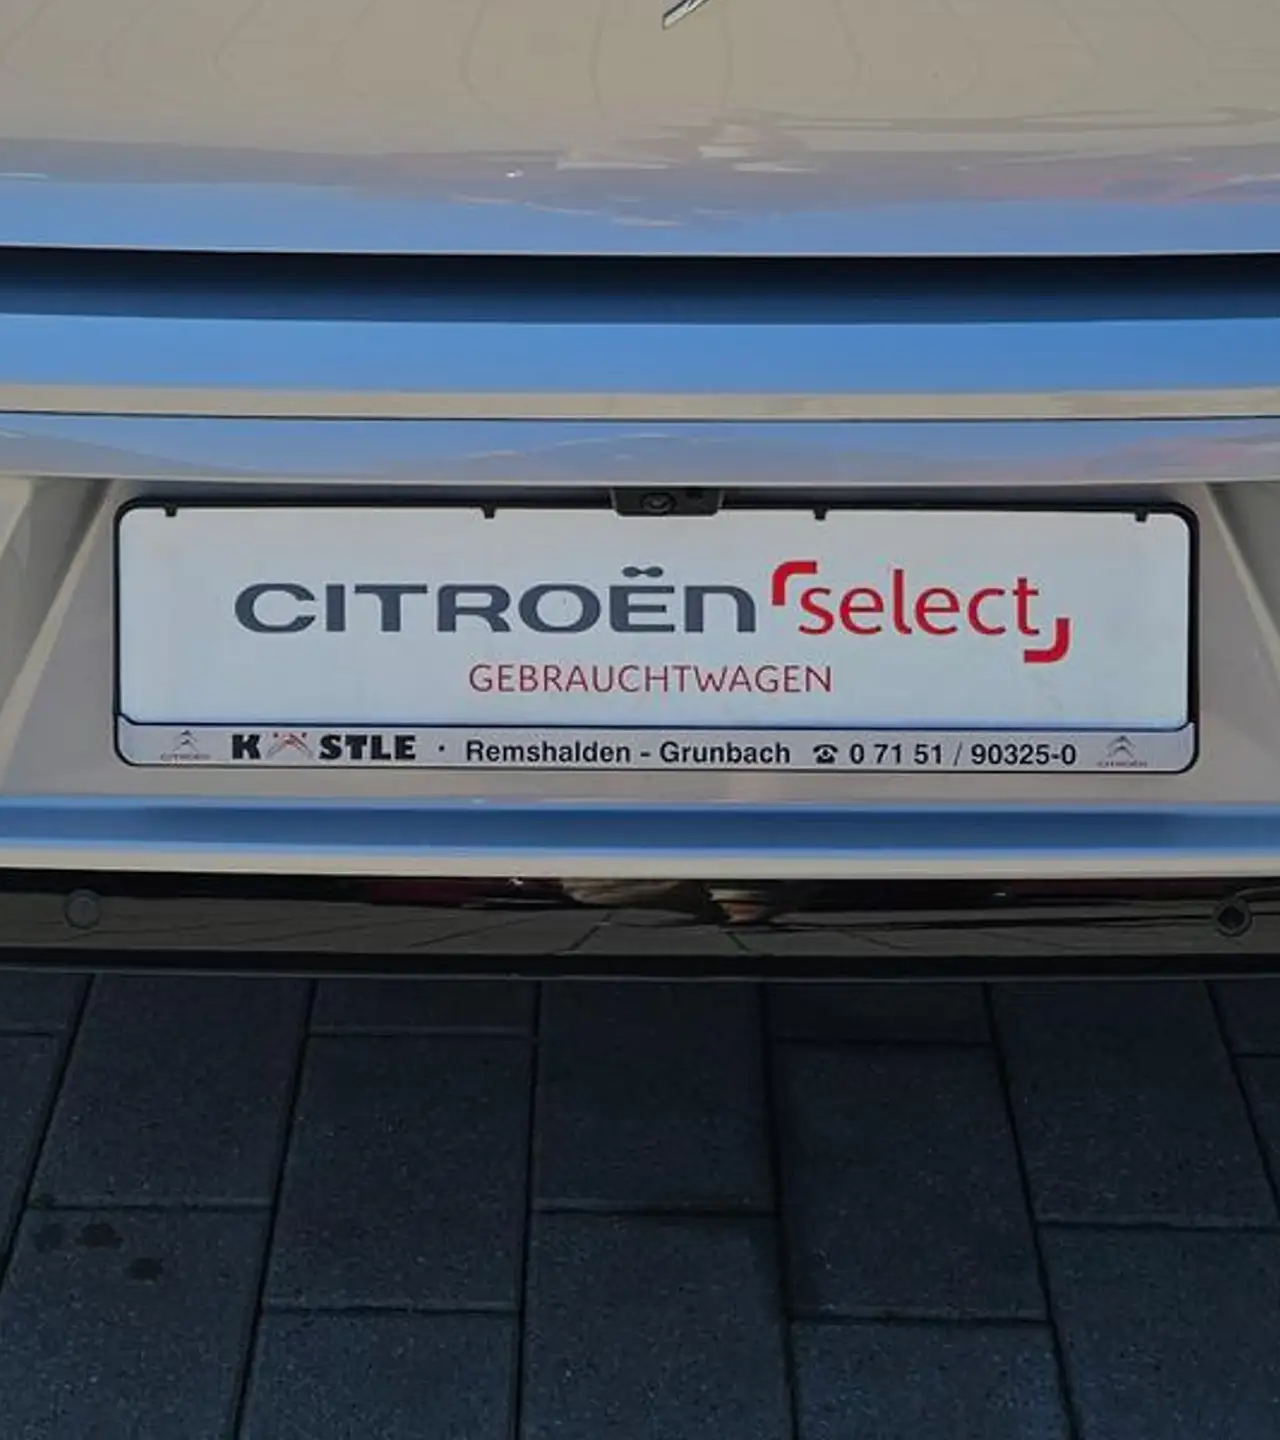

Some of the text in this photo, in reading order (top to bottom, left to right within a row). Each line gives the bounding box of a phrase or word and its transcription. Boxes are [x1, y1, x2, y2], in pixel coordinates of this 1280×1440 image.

[234, 566, 1040, 635] CITROËN select
[468, 663, 832, 694] GEBRAUCHTWAGEN
[467, 740, 630, 763] Remshalden
[660, 741, 790, 765] Grunbach
[971, 744, 1077, 765] 90325-0
